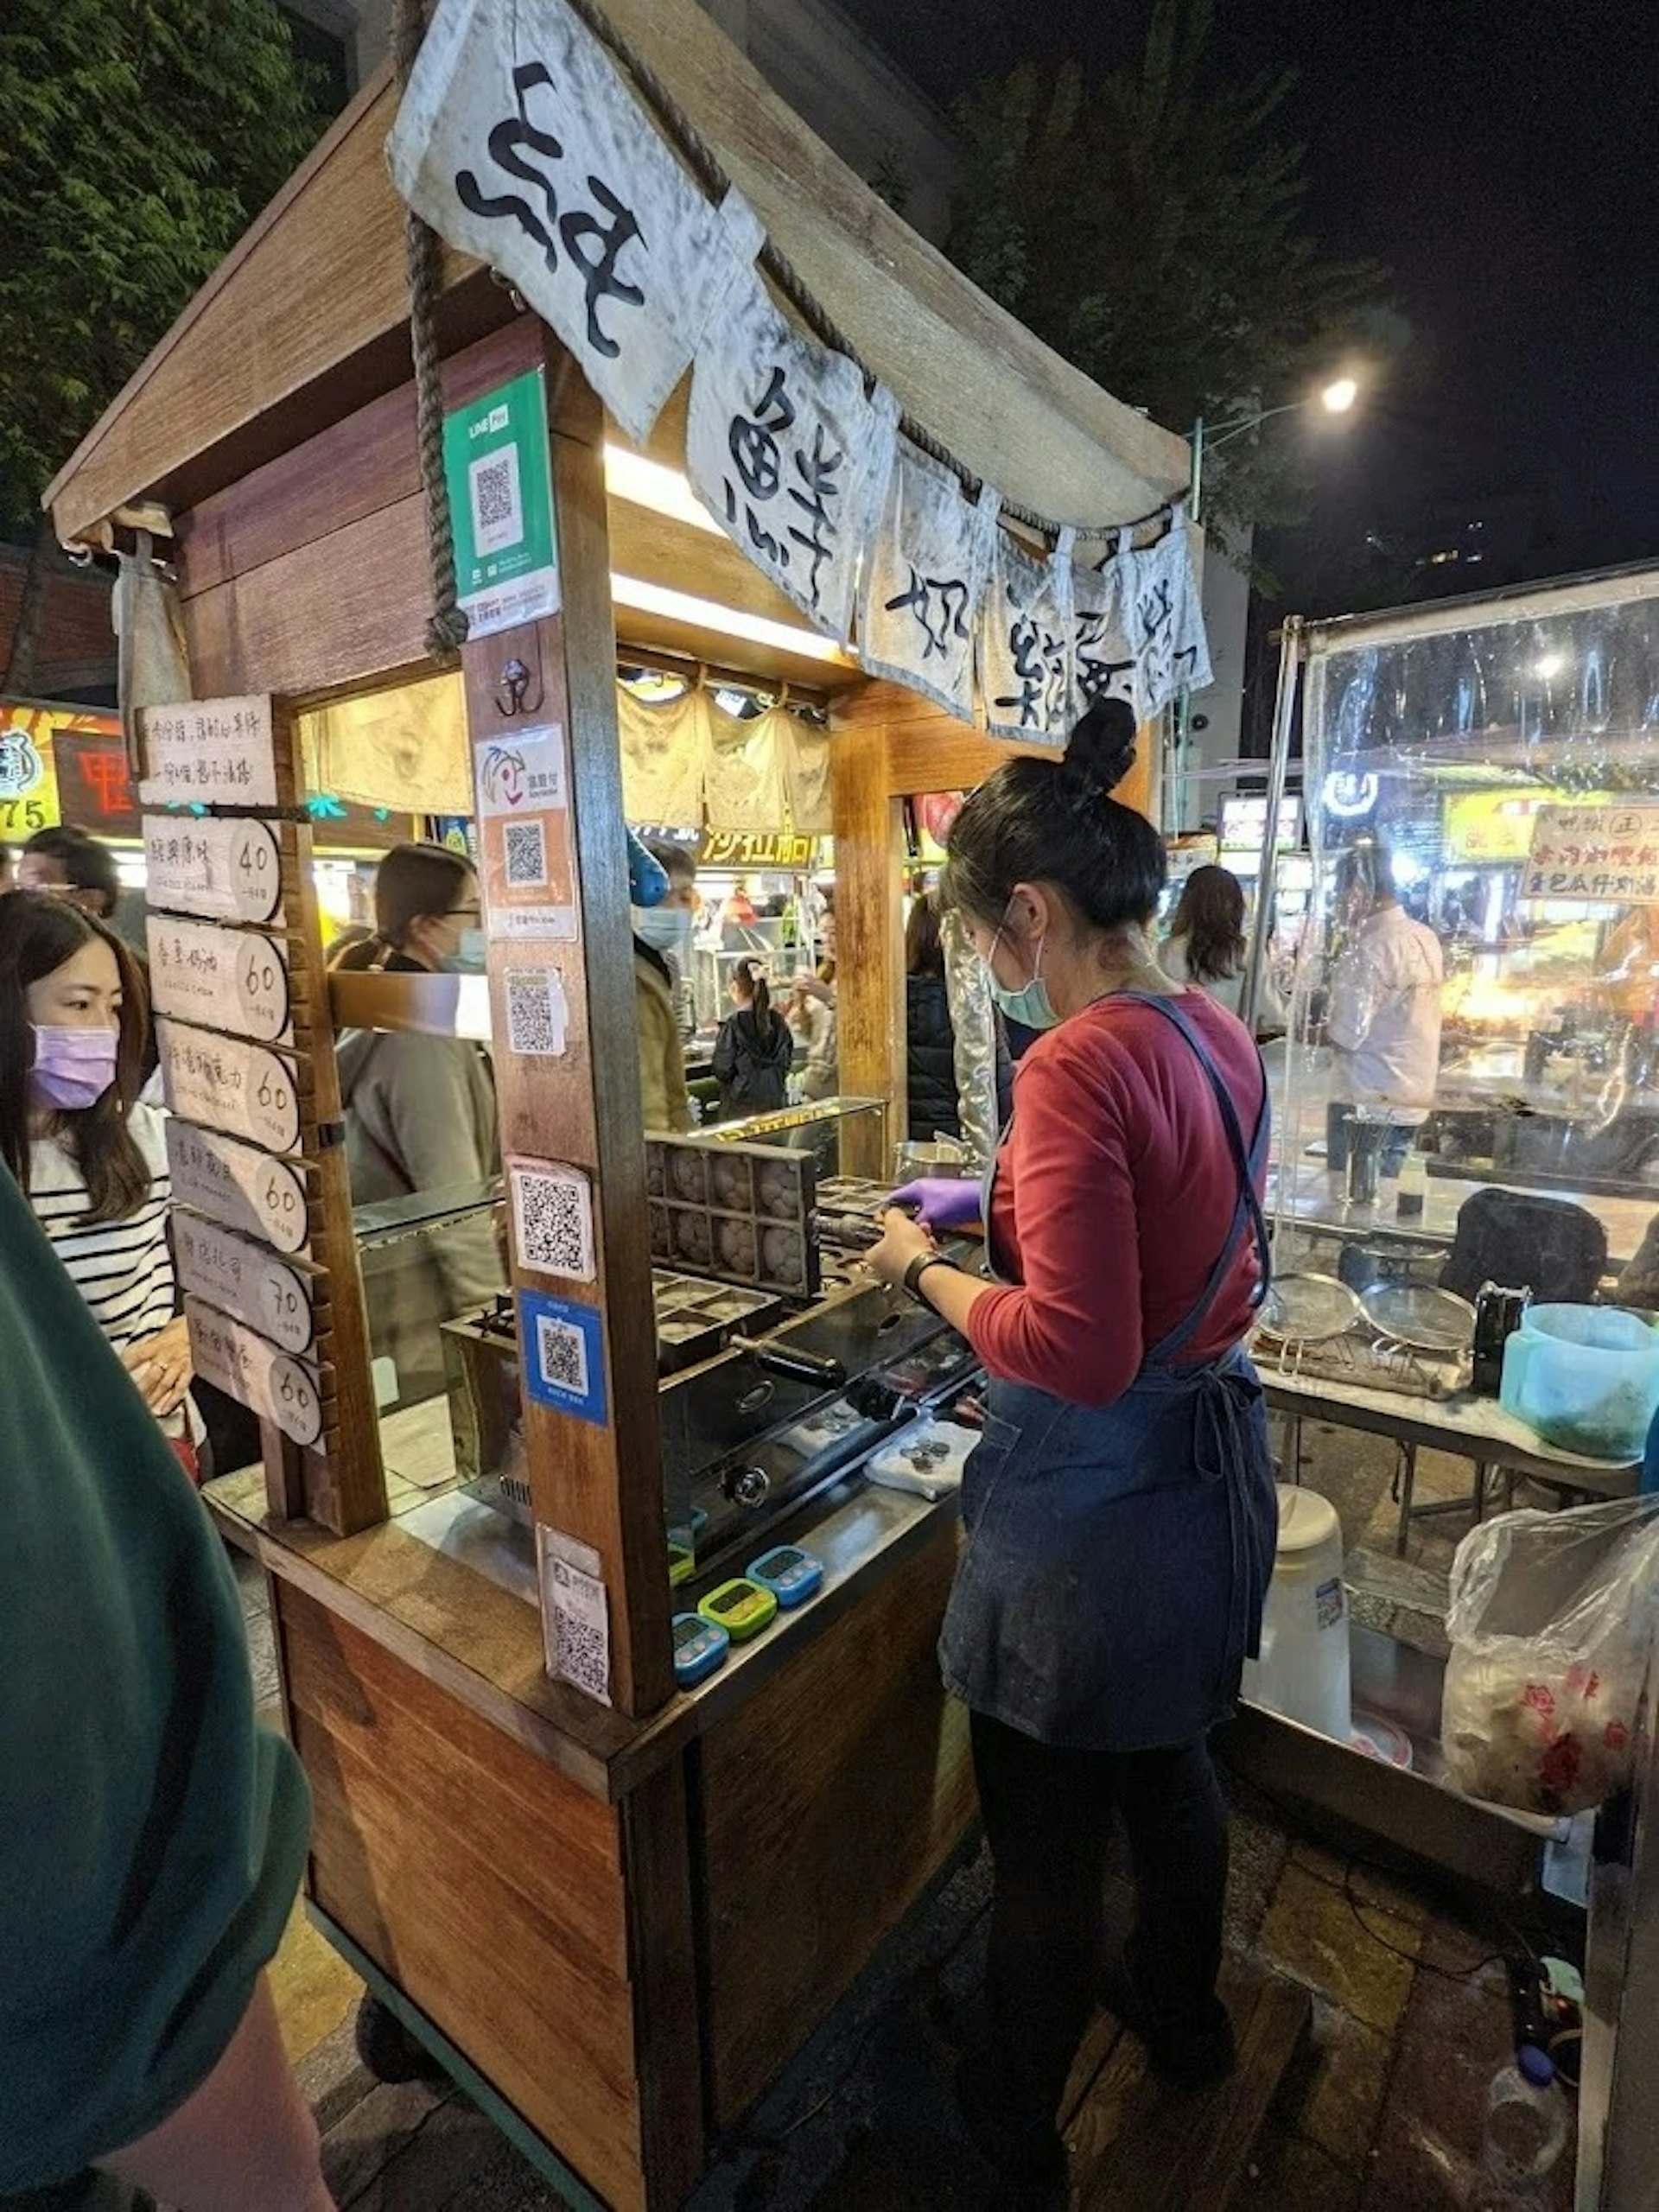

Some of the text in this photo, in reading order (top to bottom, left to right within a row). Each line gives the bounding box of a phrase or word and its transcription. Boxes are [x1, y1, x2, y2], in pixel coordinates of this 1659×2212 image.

[468, 418, 490, 439] LINE
[239, 841, 268, 877] 40
[246, 954, 274, 995] 60
[258, 1071, 287, 1110] 60
[266, 1176, 296, 1212] 60
[270, 1278, 298, 1314] 70
[281, 1373, 309, 1408] 60
